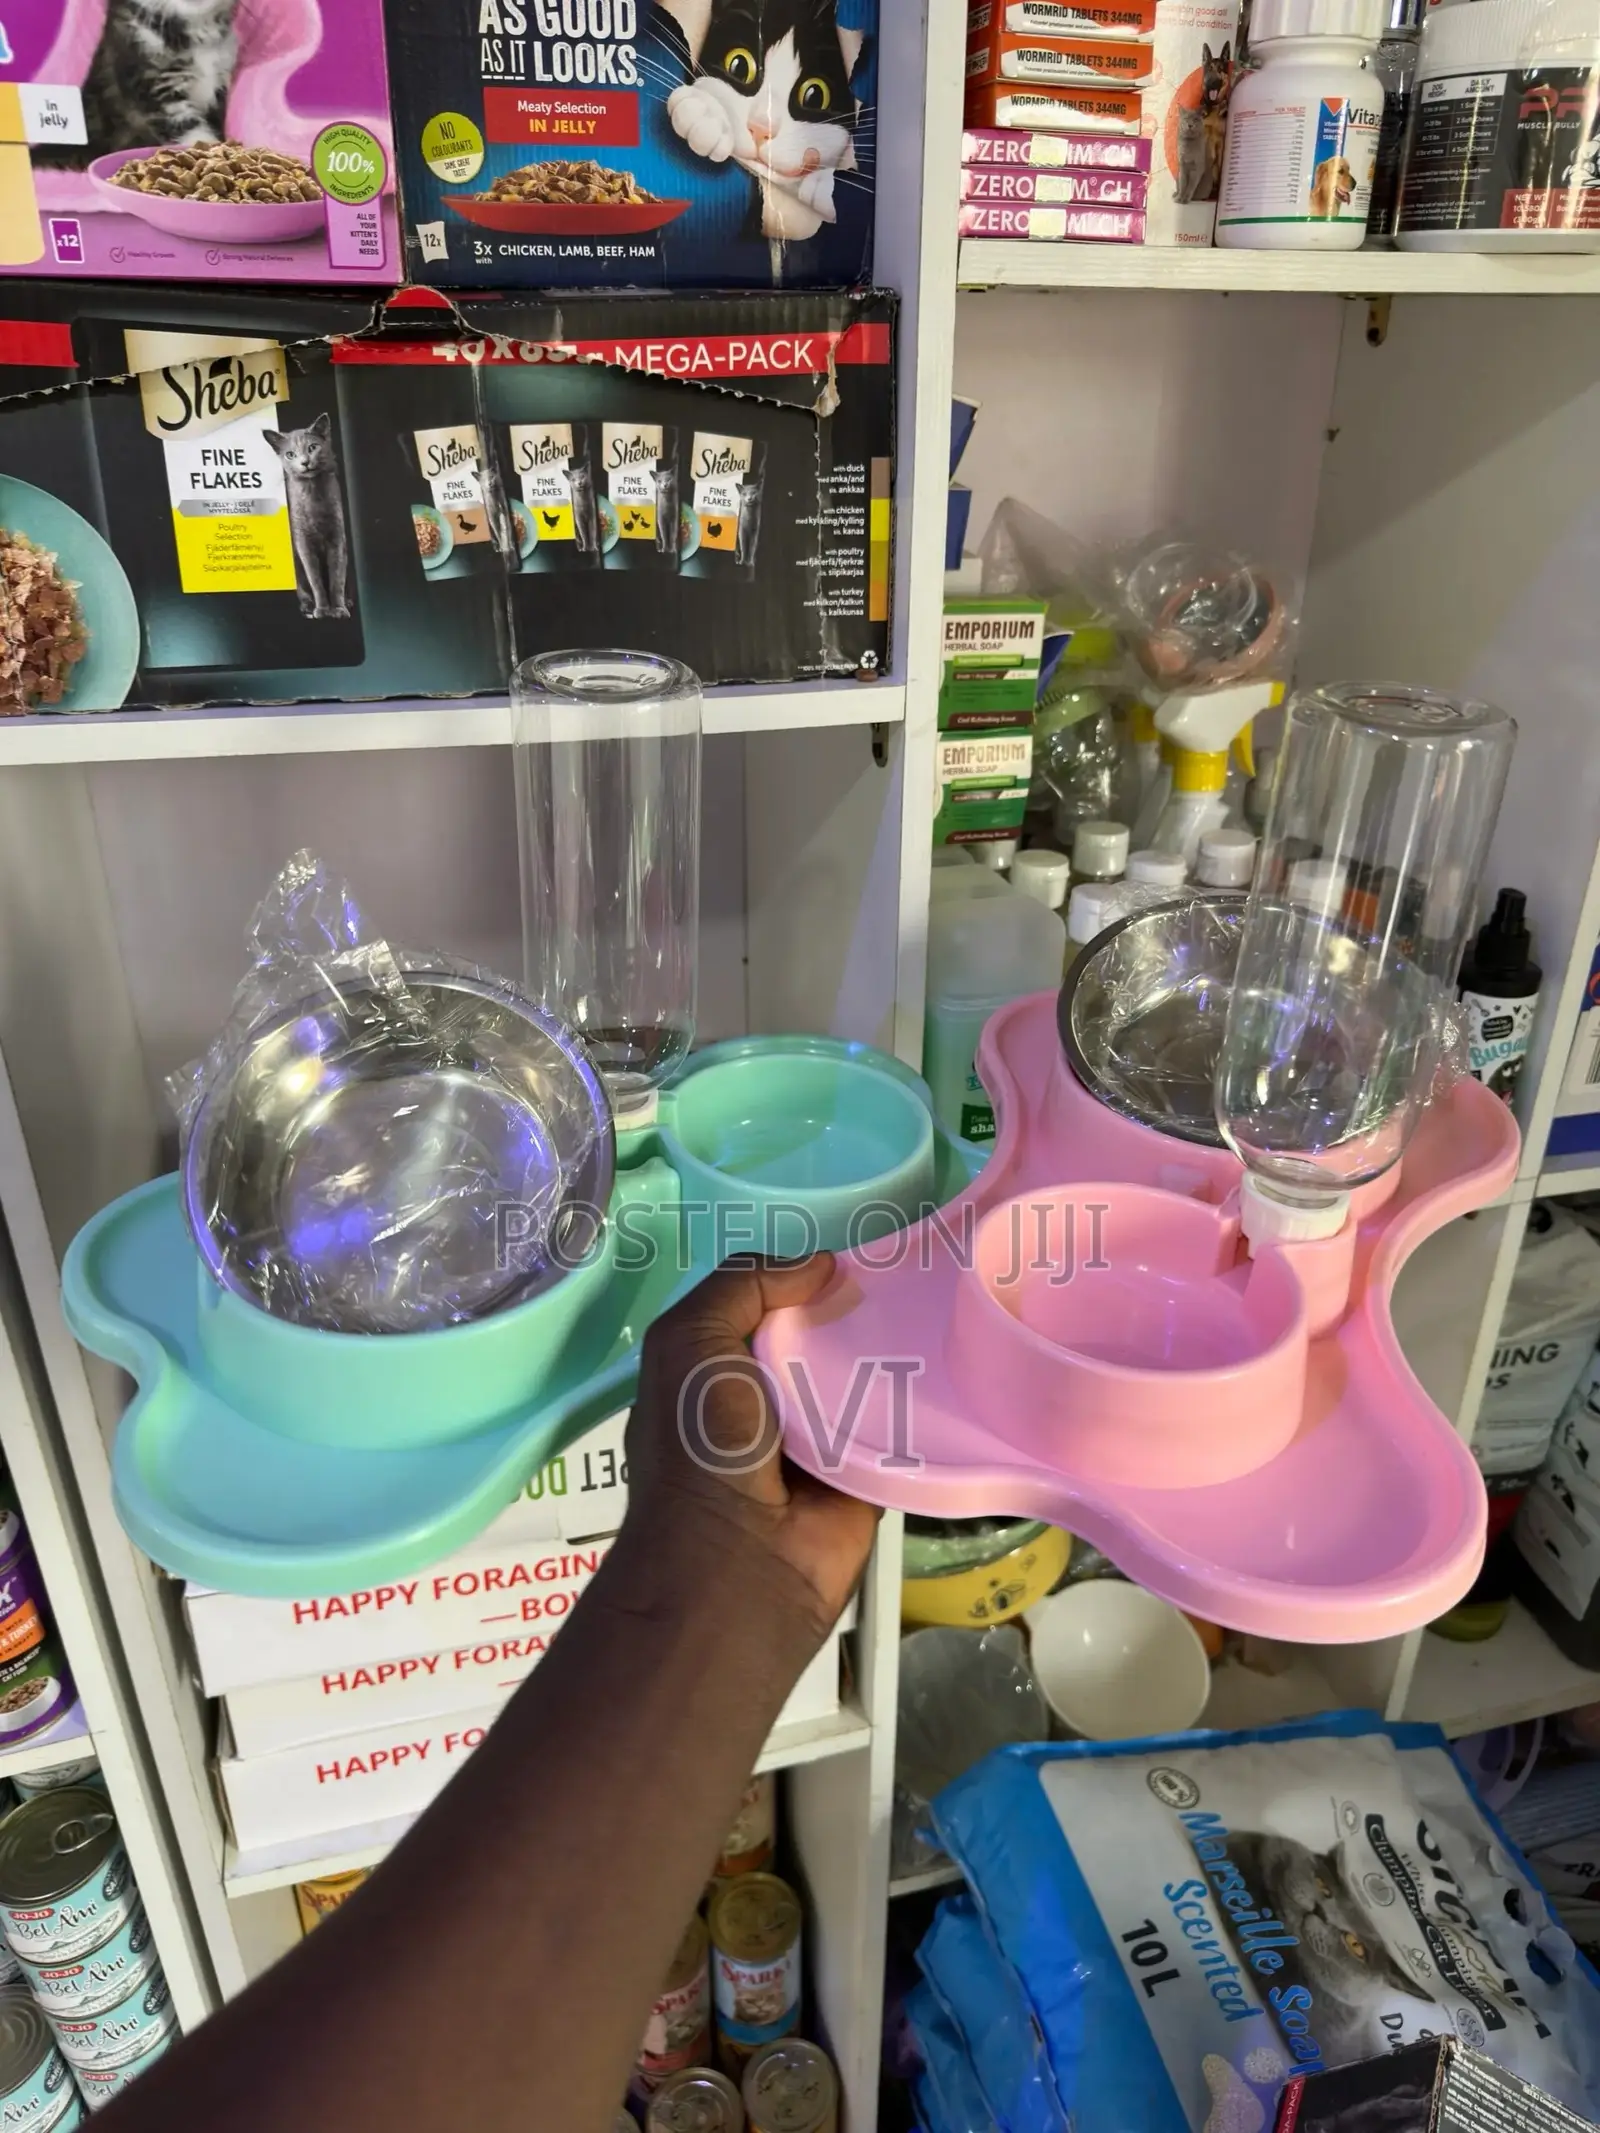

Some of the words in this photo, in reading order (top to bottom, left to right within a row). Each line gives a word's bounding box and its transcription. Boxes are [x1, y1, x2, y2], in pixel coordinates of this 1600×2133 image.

[479, 0, 527, 35] AS
[534, 0, 637, 39] GOOD
[1023, 3, 1068, 18] WORMRID
[1071, 8, 1108, 21] TABLETS
[1111, 11, 1142, 24] 344MG
[1197, 20, 1232, 29] condition
[481, 38, 505, 73] AS
[510, 40, 526, 73] IT
[1017, 49, 1062, 64] WORMRID
[1065, 54, 1103, 67] TABLETS
[1106, 57, 1137, 69] 344MG
[45, 99, 58, 111] in
[518, 100, 552, 116] Meaty
[555, 101, 607, 114] Selection
[1096, 102, 1126, 114] 344MG
[39, 112, 68, 129] jelly
[530, 119, 547, 132] IN
[552, 120, 597, 134] JELLY
[1517, 122, 1551, 130] MUSCLE
[1554, 121, 1581, 129] BULLY
[340, 129, 372, 145] QUALITY
[440, 121, 455, 140] NO
[432, 140, 473, 157] COLOURANTS
[327, 151, 375, 174] 100%
[329, 183, 374, 199] INGREDIENTS
[1099, 180, 1132, 202] CH
[57, 234, 79, 249] x12
[361, 239, 378, 247] DAILY
[424, 234, 442, 247] 12x
[474, 241, 492, 255] 3x
[359, 248, 379, 256] NEEDS
[499, 245, 556, 257] CHICKEN,
[559, 246, 594, 257] LAMB,
[597, 246, 626, 258] BEEF,
[630, 247, 655, 257] HAM
[614, 339, 814, 374] MEGA-PACK
[157, 358, 277, 431] Sheba
[202, 449, 247, 466] FINE
[428, 445, 476, 477] Sheba
[519, 440, 569, 471] Sheba
[608, 439, 658, 469] Sheba
[695, 449, 746, 478] Sheba
[846, 464, 865, 472] duck
[191, 472, 262, 490] FLAKES
[447, 481, 464, 489] FINE
[537, 478, 555, 486] FINE
[624, 477, 642, 485] FINE
[831, 475, 865, 484] anka/and
[443, 490, 473, 500] FLAKES
[532, 488, 562, 496] FLAKES
[618, 487, 648, 495] FLAKES
[709, 488, 727, 496] FINE
[839, 485, 865, 493] ankkaa
[703, 498, 732, 507] FLAKES
[836, 506, 865, 514] chicken
[218, 523, 247, 532] Poultry
[838, 547, 865, 556] poultry
[841, 588, 865, 597] turkey
[945, 620, 1035, 640] EMPORIUM
[944, 643, 977, 651] HERBAL
[980, 642, 1003, 650] SOAP
[943, 744, 1025, 765] EMPORIUM
[293, 1582, 420, 1625] HAPPY
[432, 1550, 607, 1600] FORAGIN
[321, 1654, 442, 1695] HAPPY
[453, 1633, 557, 1669] FORA
[316, 1738, 431, 1784] HAPPY
[1369, 1824, 1425, 1921] Clumping
[1178, 1812, 1301, 1975] Marseille
[12, 1909, 51, 1921] JO-JO
[13, 1921, 51, 1940] Bel
[54, 1900, 99, 1934] Ami
[1163, 1879, 1265, 2022] Scented
[1426, 1925, 1448, 1965] Cat
[42, 1967, 80, 1979] JO-JO
[42, 1979, 80, 1998] Bel
[83, 1953, 127, 1990] Ami
[59, 2023, 93, 2032] JO-JO
[62, 2033, 93, 2049] Bel
[96, 2015, 140, 2045] Ami
[83, 2073, 115, 2081] JO-JO
[0, 2095, 41, 2126] Ami
